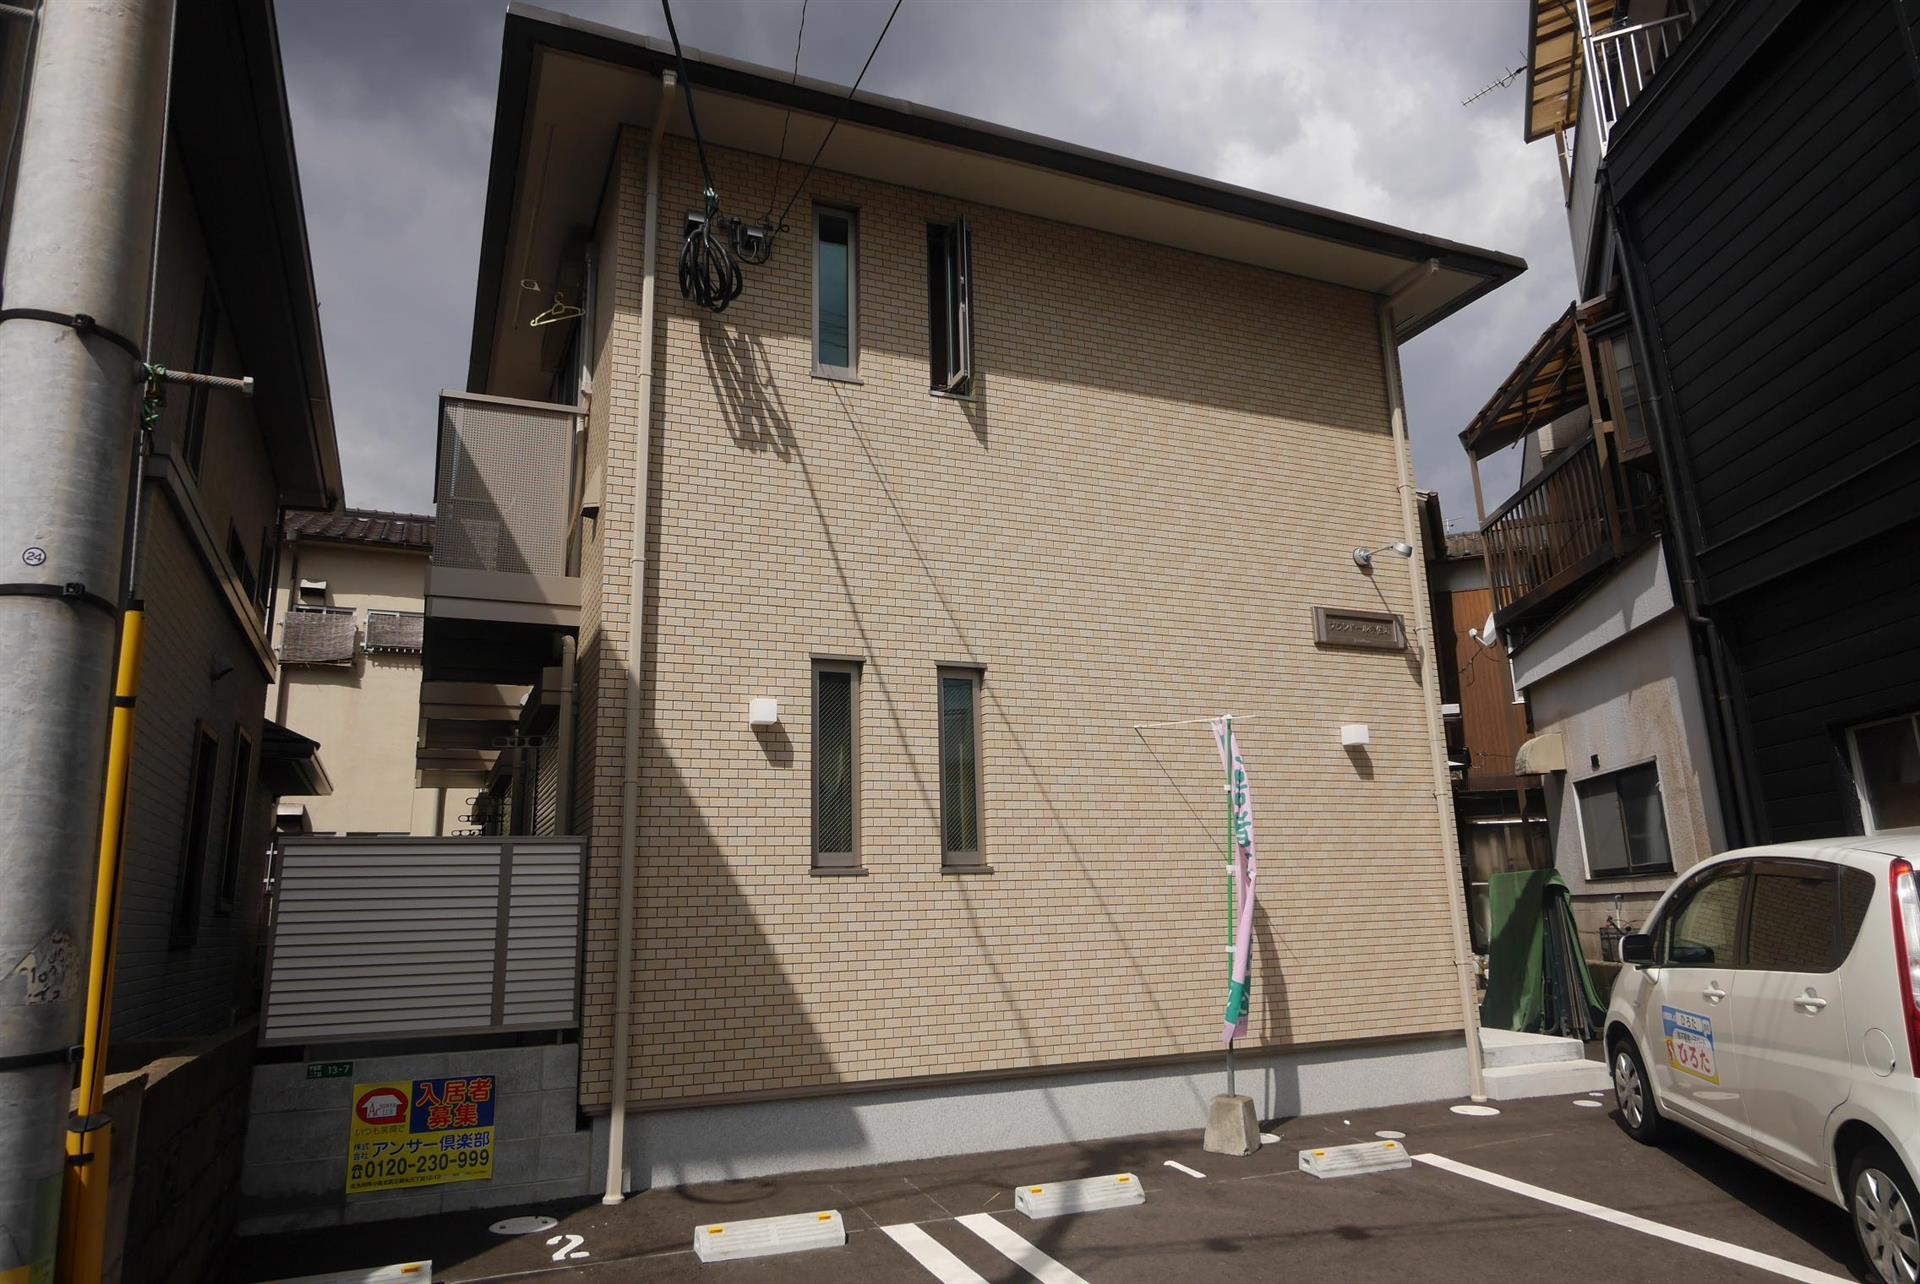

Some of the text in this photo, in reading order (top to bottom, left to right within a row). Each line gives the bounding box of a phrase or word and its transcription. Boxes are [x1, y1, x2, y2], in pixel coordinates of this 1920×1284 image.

[26, 551, 42, 562] 24
[1677, 1042, 1711, 1073] ひろた
[416, 1077, 493, 1107] 入居者
[427, 1103, 479, 1130] 募集
[372, 1131, 490, 1158] アンサー倶楽部
[365, 1149, 490, 1178] 0120-230-999
[545, 1234, 590, 1262] 2
